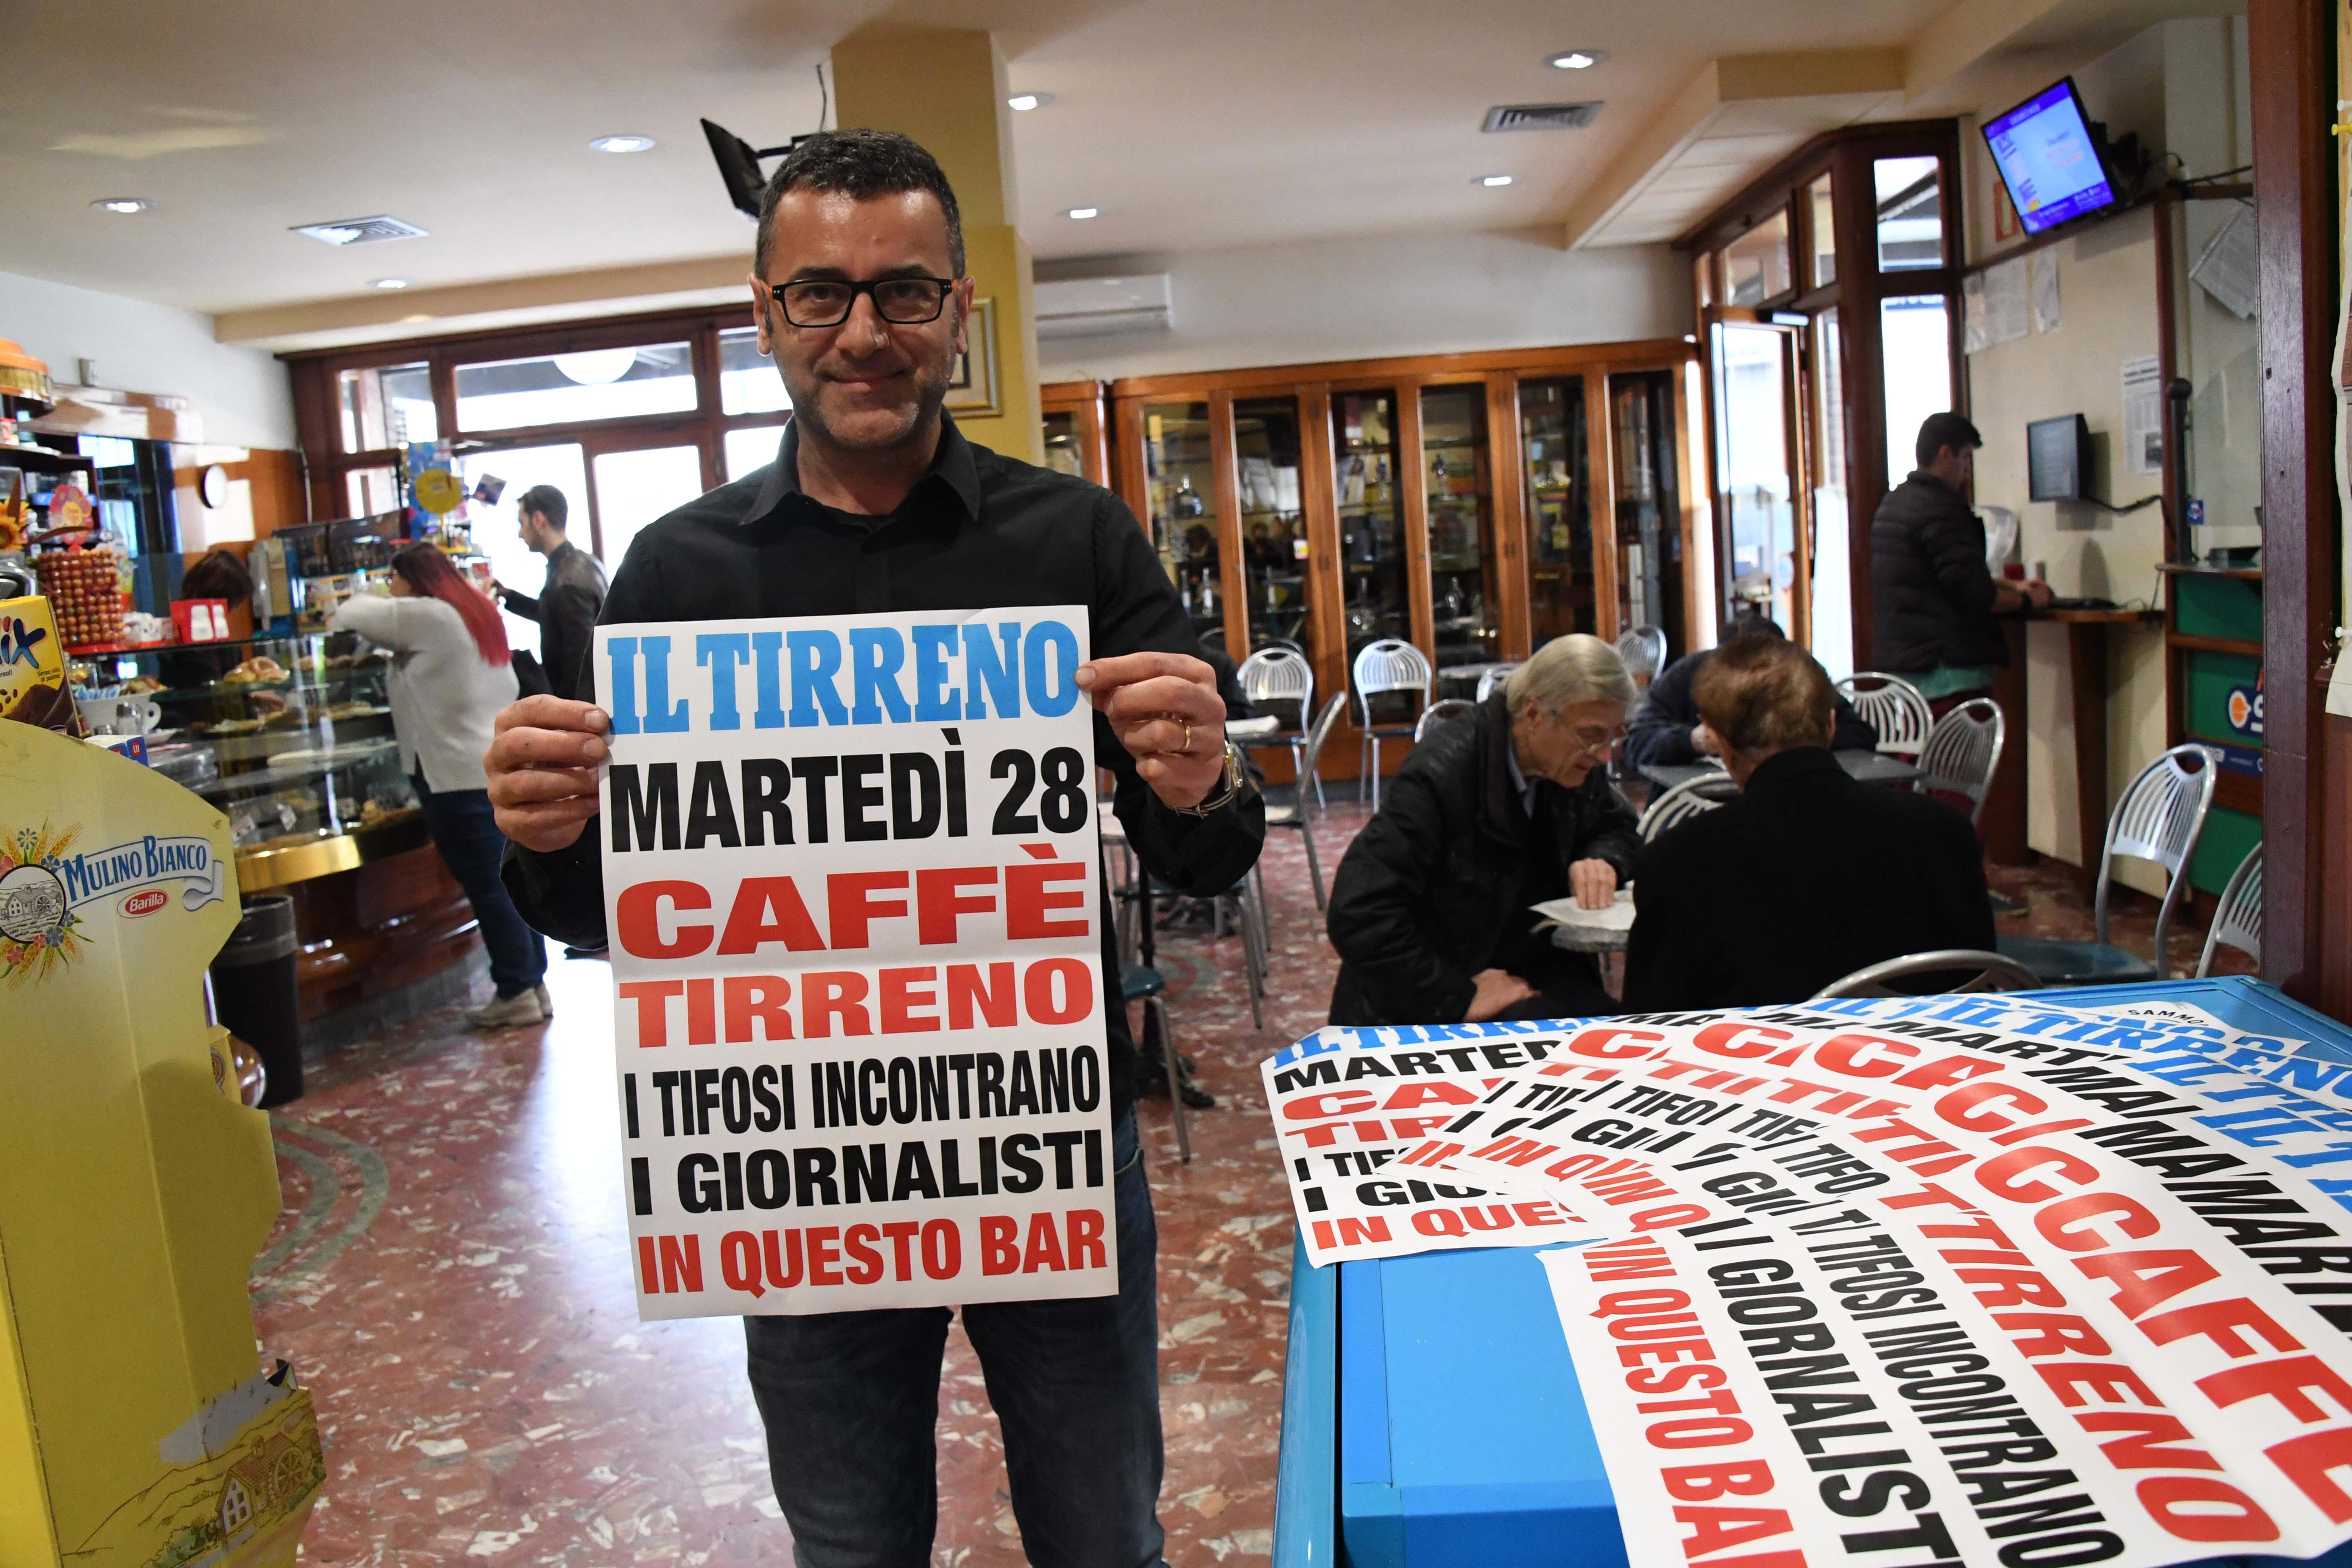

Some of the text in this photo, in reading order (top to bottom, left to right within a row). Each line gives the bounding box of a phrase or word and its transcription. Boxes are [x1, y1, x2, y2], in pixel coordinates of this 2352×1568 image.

[0, 615, 46, 669] ix
[607, 621, 1080, 735] IL TIRRENO
[133, 744, 140, 753] LU
[609, 728, 1088, 853] MARTEDÌ 28
[63, 835, 207, 903] MULINO BIANCO
[129, 894, 164, 912] Barilla
[616, 843, 1089, 959] CAFFÈ
[619, 958, 1094, 1048] TIRRENO
[2128, 1010, 2209, 1026] SAMMO
[625, 1045, 1100, 1139] I TIFOSI INCONTRANO
[632, 1130, 1104, 1216] I GIORNALISTI
[638, 1209, 1107, 1298] IN QUESTO BAR
[1312, 1215, 1392, 1250] IN
[1807, 1234, 1946, 1321] TIFOSI
[1587, 1288, 1753, 1449] QUESTO
[1707, 1259, 1967, 1568] GIORNALIST
[1916, 1217, 2281, 1542] TIRRENO
[1862, 1321, 2125, 1568] INCONTRANO
[1660, 1459, 1808, 1568] BA
